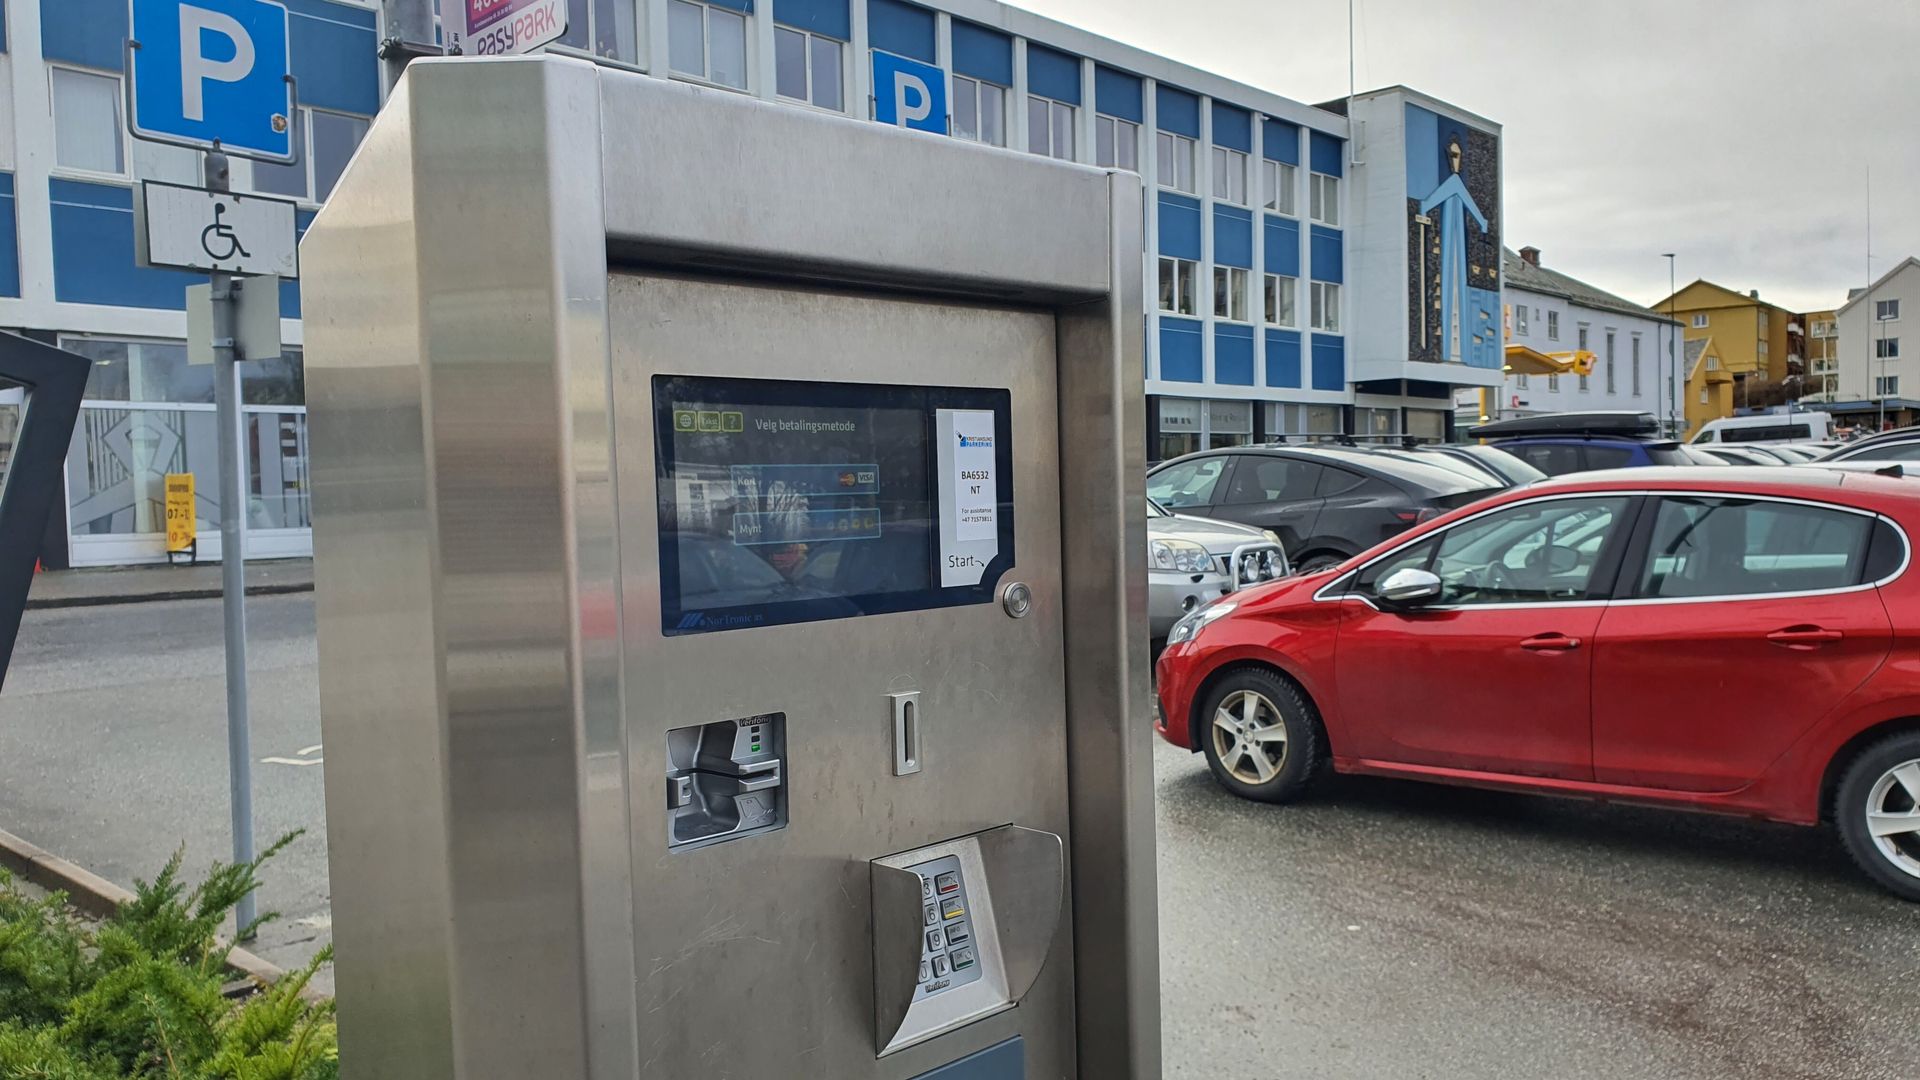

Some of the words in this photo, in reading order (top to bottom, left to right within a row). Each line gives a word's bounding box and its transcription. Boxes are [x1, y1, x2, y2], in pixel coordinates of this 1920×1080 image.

[178, 2, 256, 122] P
[893, 69, 932, 129] P
[755, 419, 777, 433] Velg
[779, 418, 856, 434] betalingsmetode
[859, 473, 874, 481] VISA
[961, 471, 989, 480] BA6532
[970, 485, 981, 495] NT
[739, 525, 762, 536] Mynt
[948, 555, 974, 568] Start
[924, 882, 931, 895] 3
[929, 909, 936, 920] 6
[934, 934, 940, 946] 9
